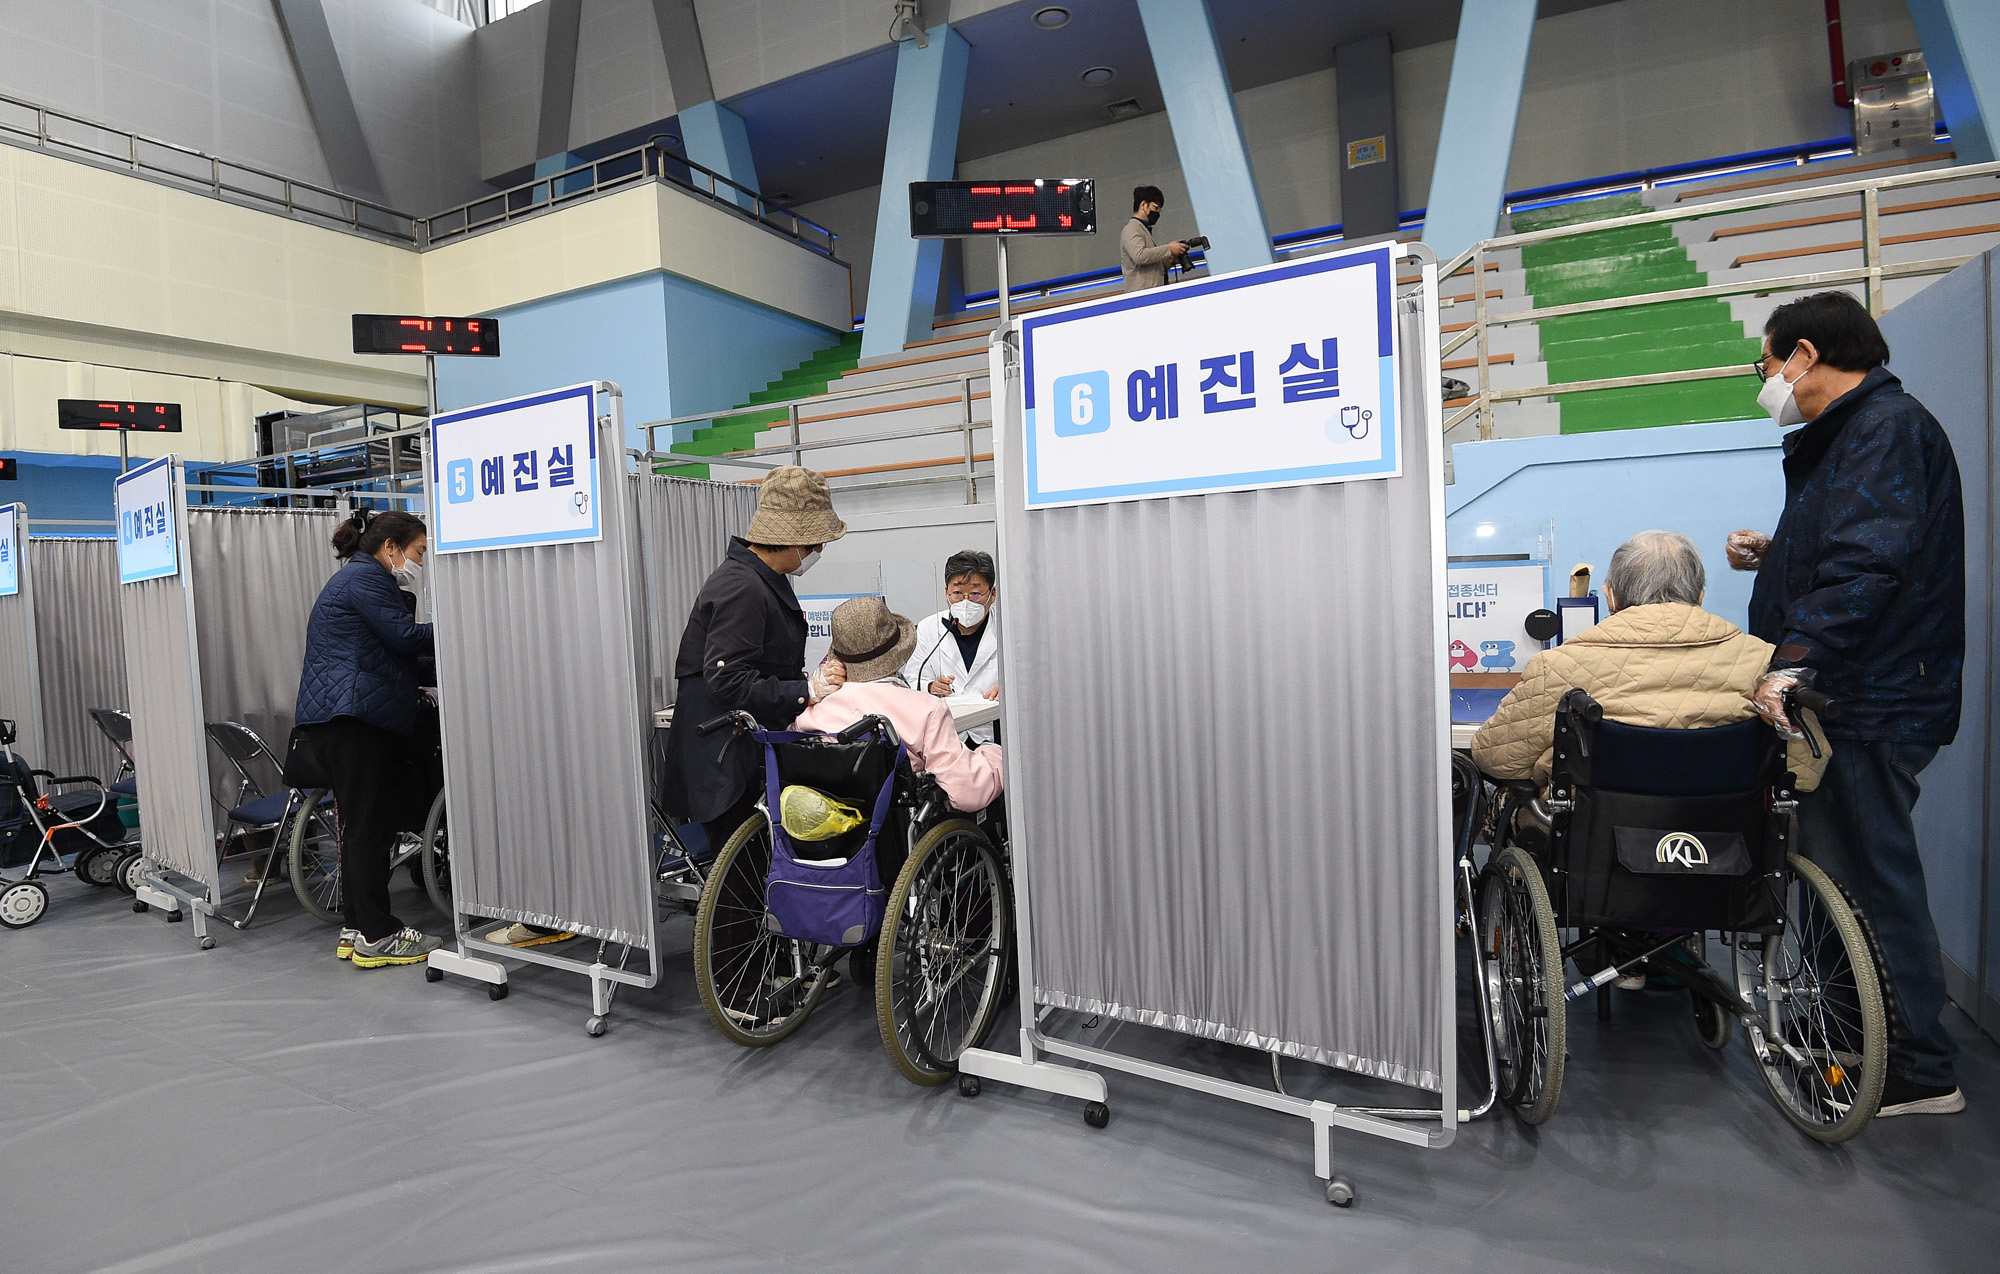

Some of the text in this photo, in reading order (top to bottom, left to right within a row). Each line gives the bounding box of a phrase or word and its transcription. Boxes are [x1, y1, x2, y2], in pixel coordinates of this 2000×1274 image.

[1070, 337, 1340, 426] 6 예진실
[454, 444, 575, 497] 5 예진실
[125, 501, 166, 540] 4 예진실
[1448, 583, 1498, 598] 접종센터
[806, 624, 831, 637] 합니
